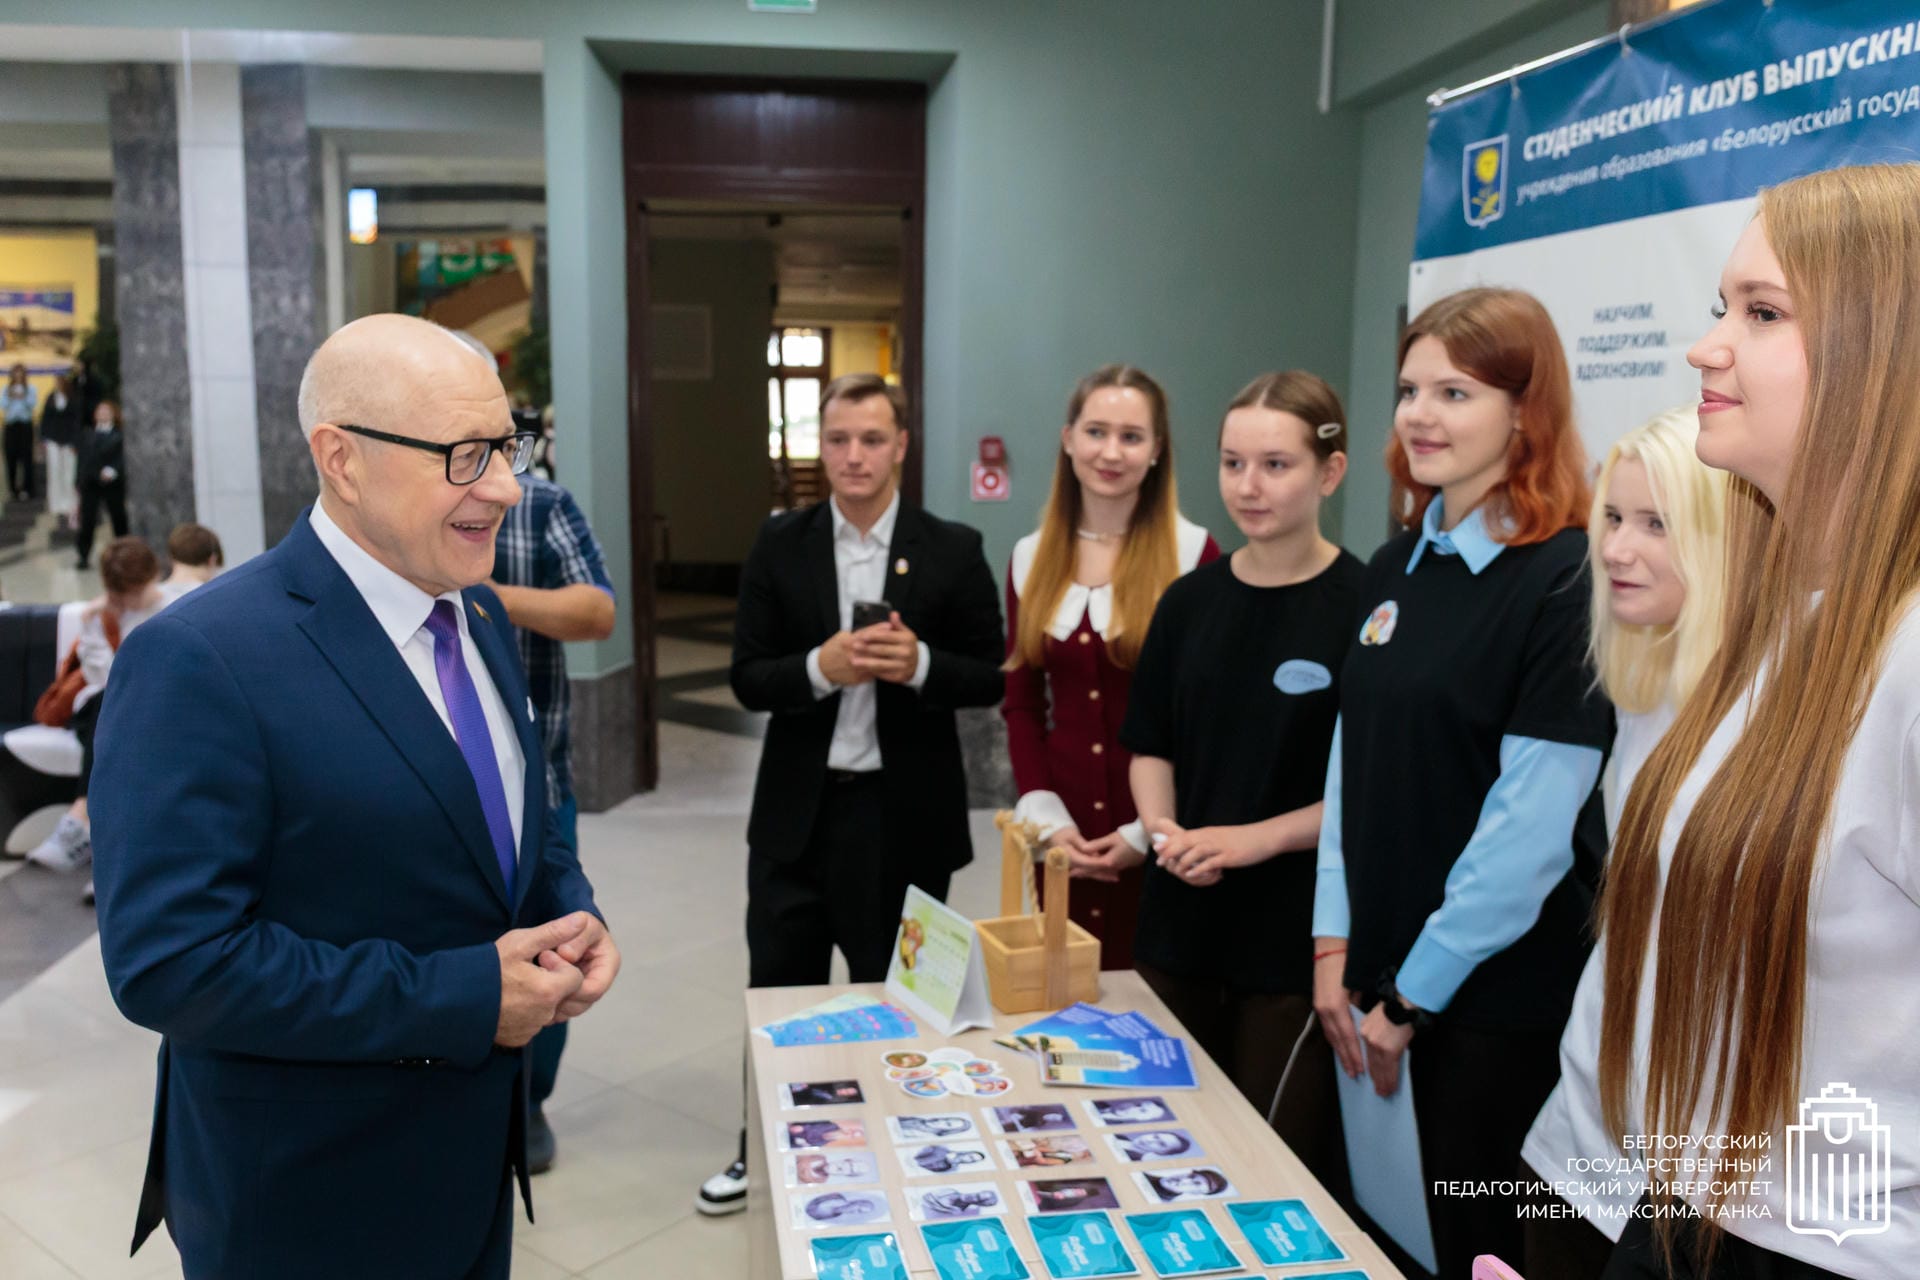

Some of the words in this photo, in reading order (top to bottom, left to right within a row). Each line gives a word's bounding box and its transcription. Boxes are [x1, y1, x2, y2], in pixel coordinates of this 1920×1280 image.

[1523, 84, 1683, 161] СТУДЕНЧЕСКИЙ
[1688, 70, 1758, 115] КЛУБ
[1601, 138, 1708, 181] образования
[1712, 96, 1852, 151] «Белорусский
